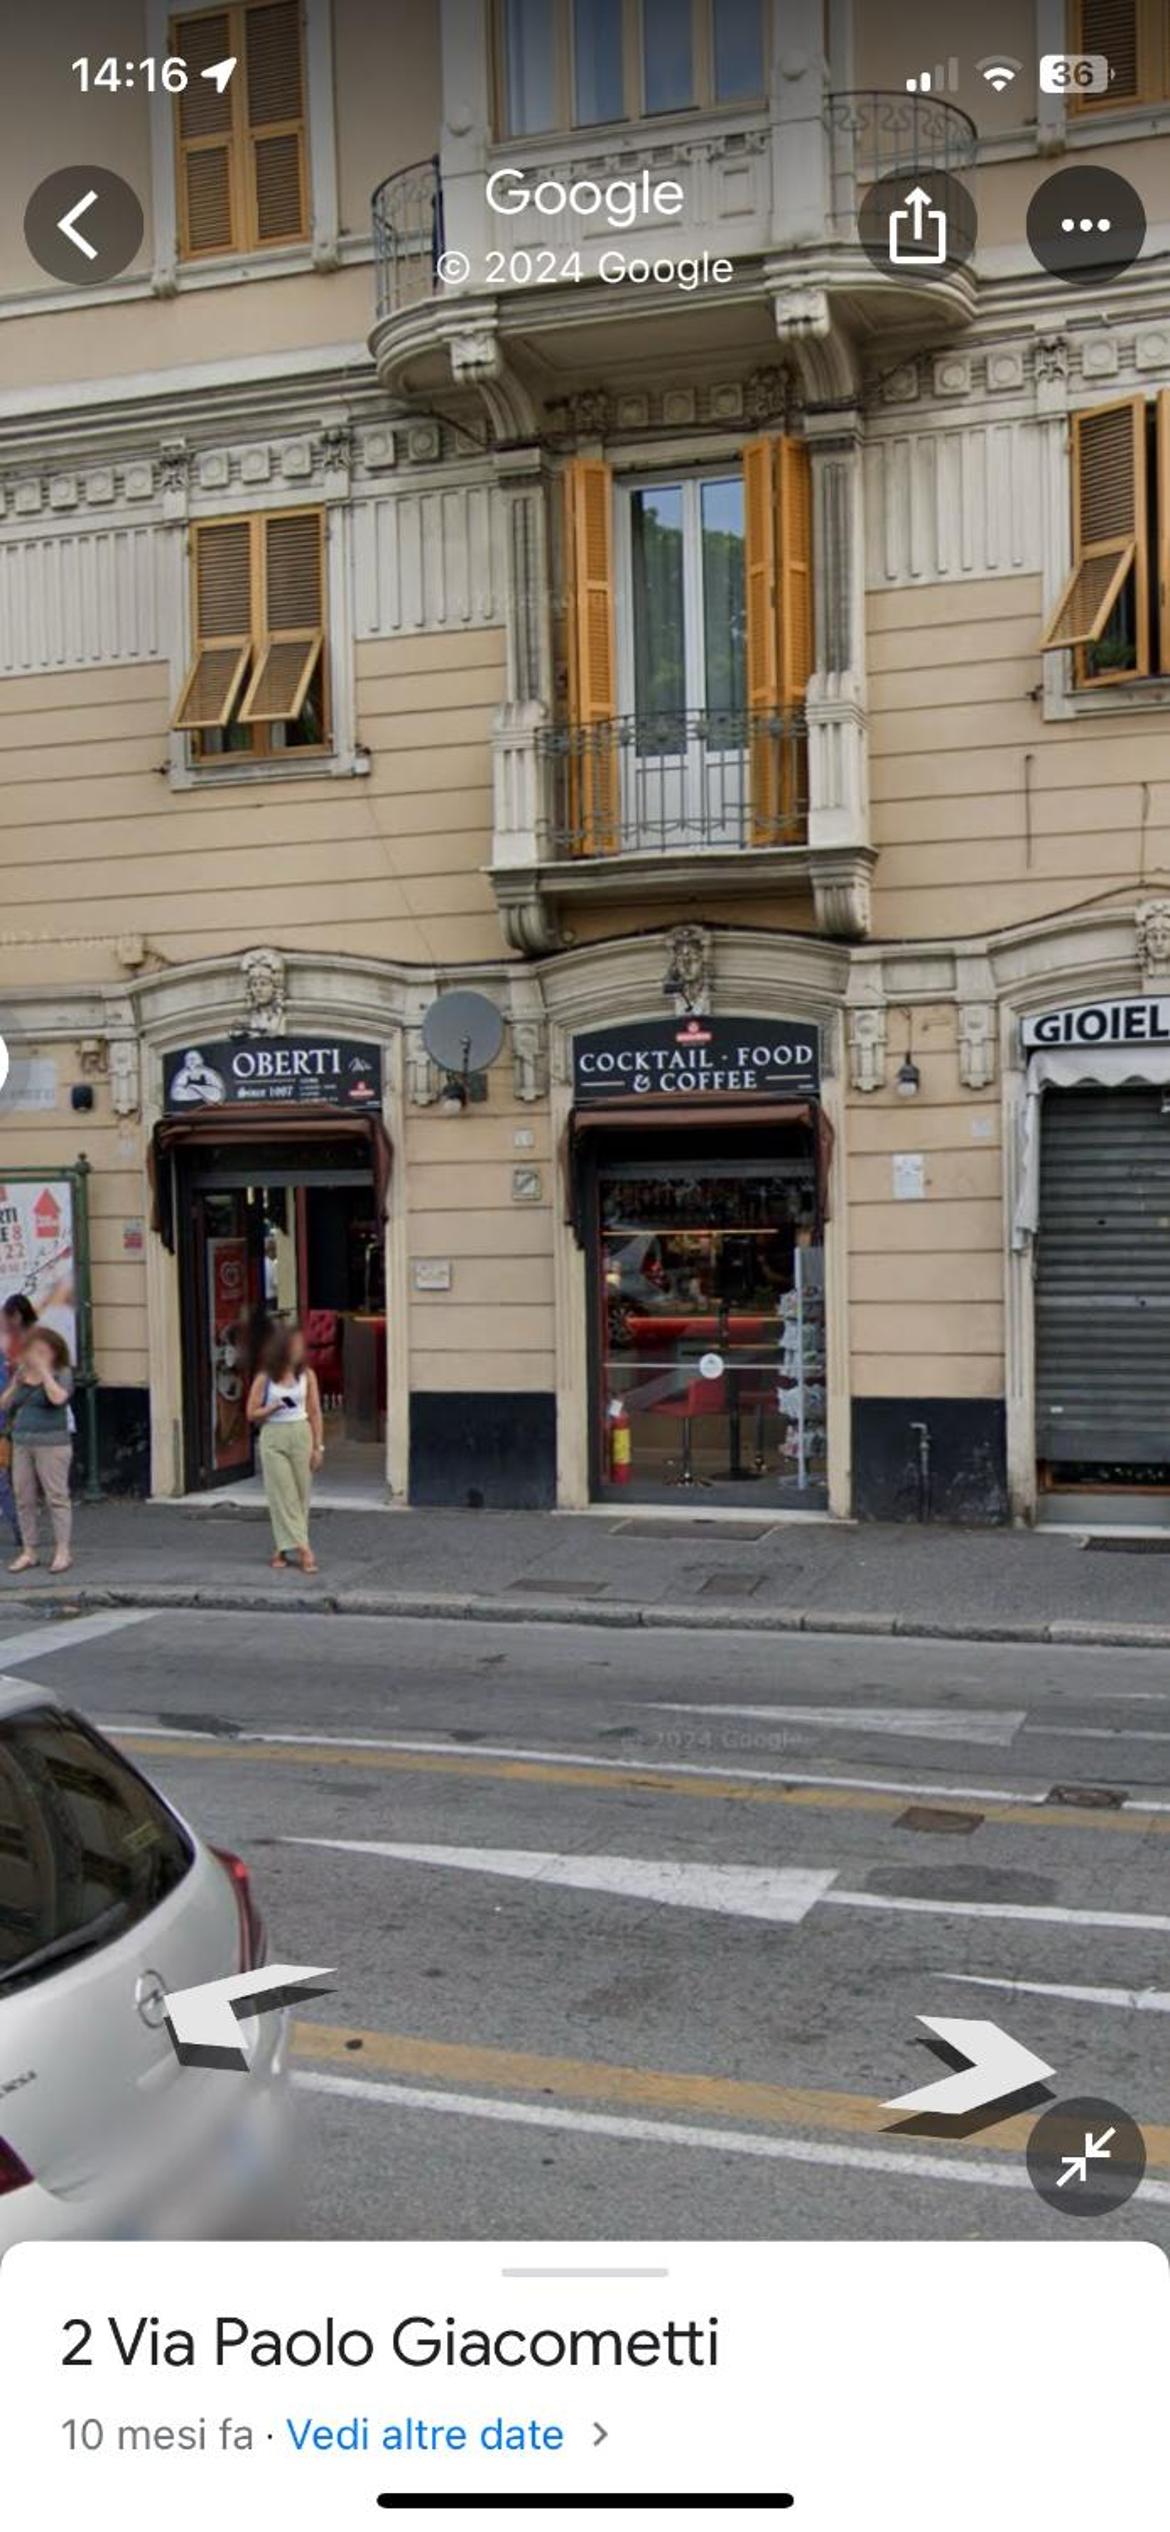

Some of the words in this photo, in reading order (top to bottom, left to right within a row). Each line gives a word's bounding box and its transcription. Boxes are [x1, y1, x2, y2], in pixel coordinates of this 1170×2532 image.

[232, 1048, 341, 1077] OBERTI
[579, 1049, 714, 1073] COCKTAIL
[737, 1044, 813, 1066] FOOD
[633, 1074, 651, 1093] &
[659, 1070, 758, 1092] COFFEE
